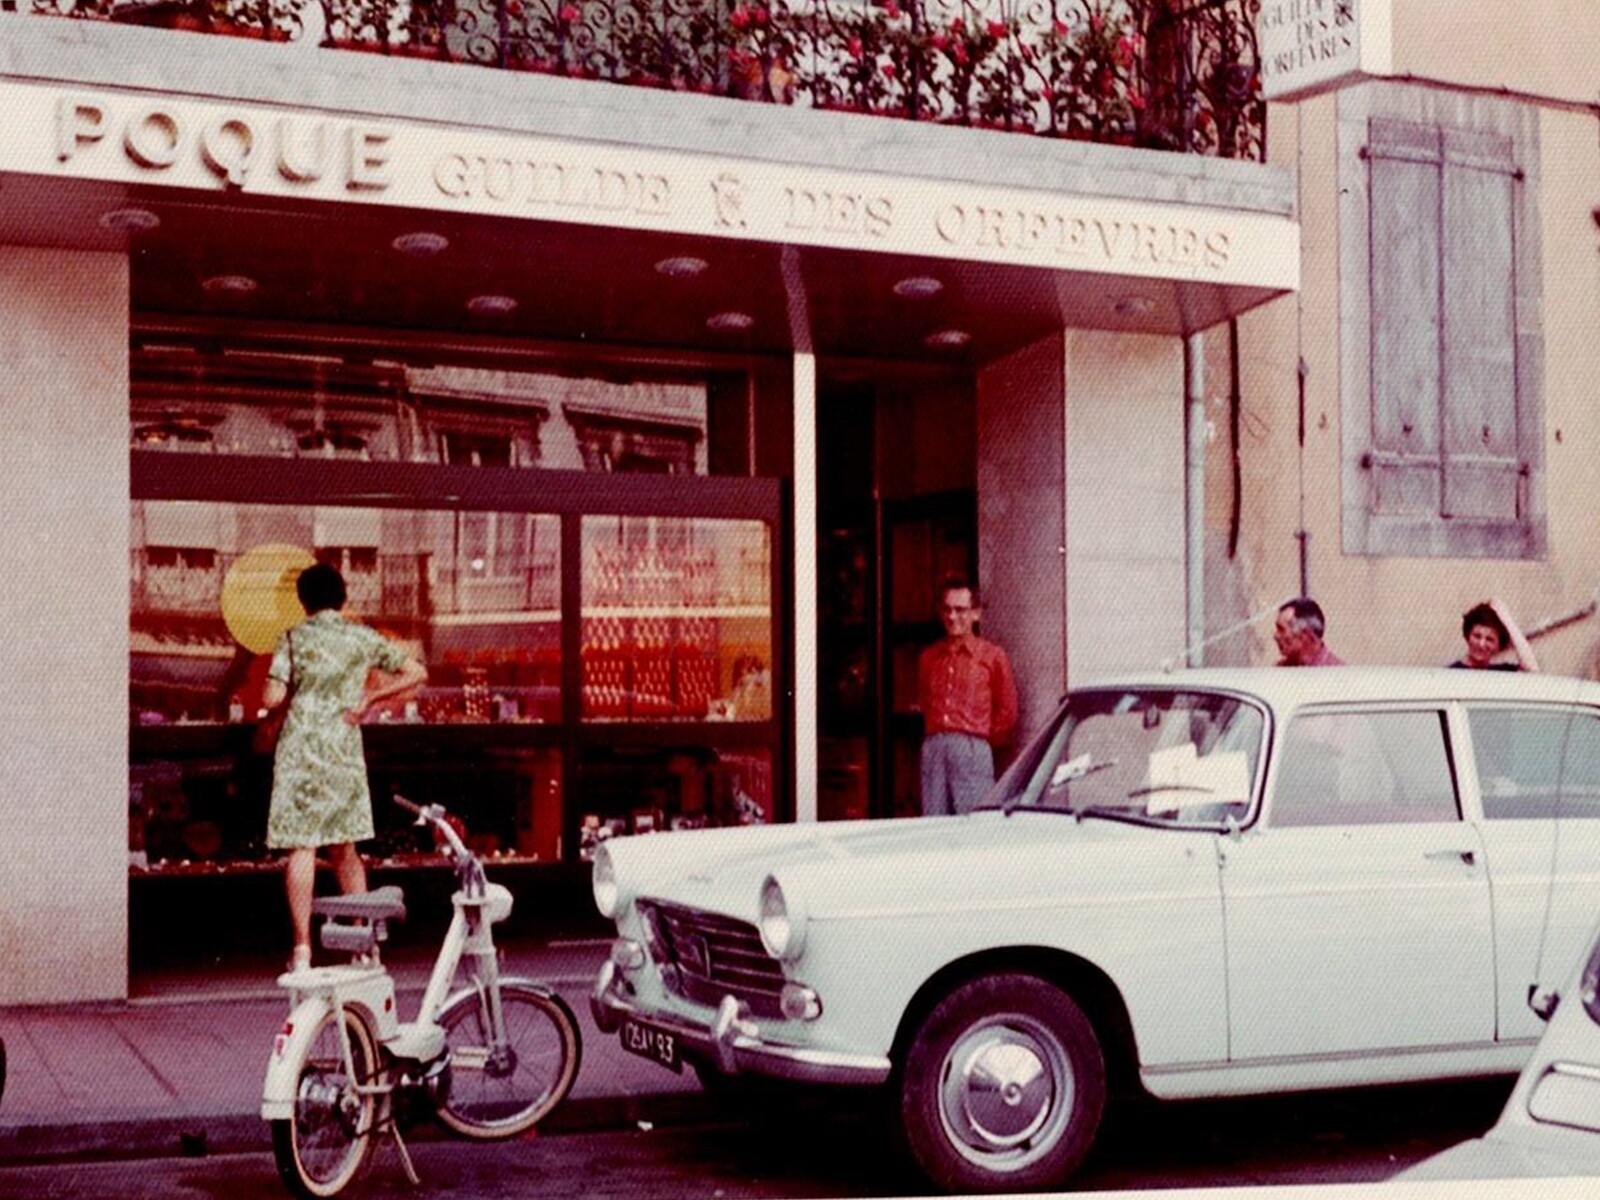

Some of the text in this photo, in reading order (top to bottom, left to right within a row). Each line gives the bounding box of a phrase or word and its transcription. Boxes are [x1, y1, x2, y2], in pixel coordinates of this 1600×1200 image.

[56, 96, 392, 193] POQUE
[432, 152, 672, 217] GUILDE
[784, 184, 894, 239] DES
